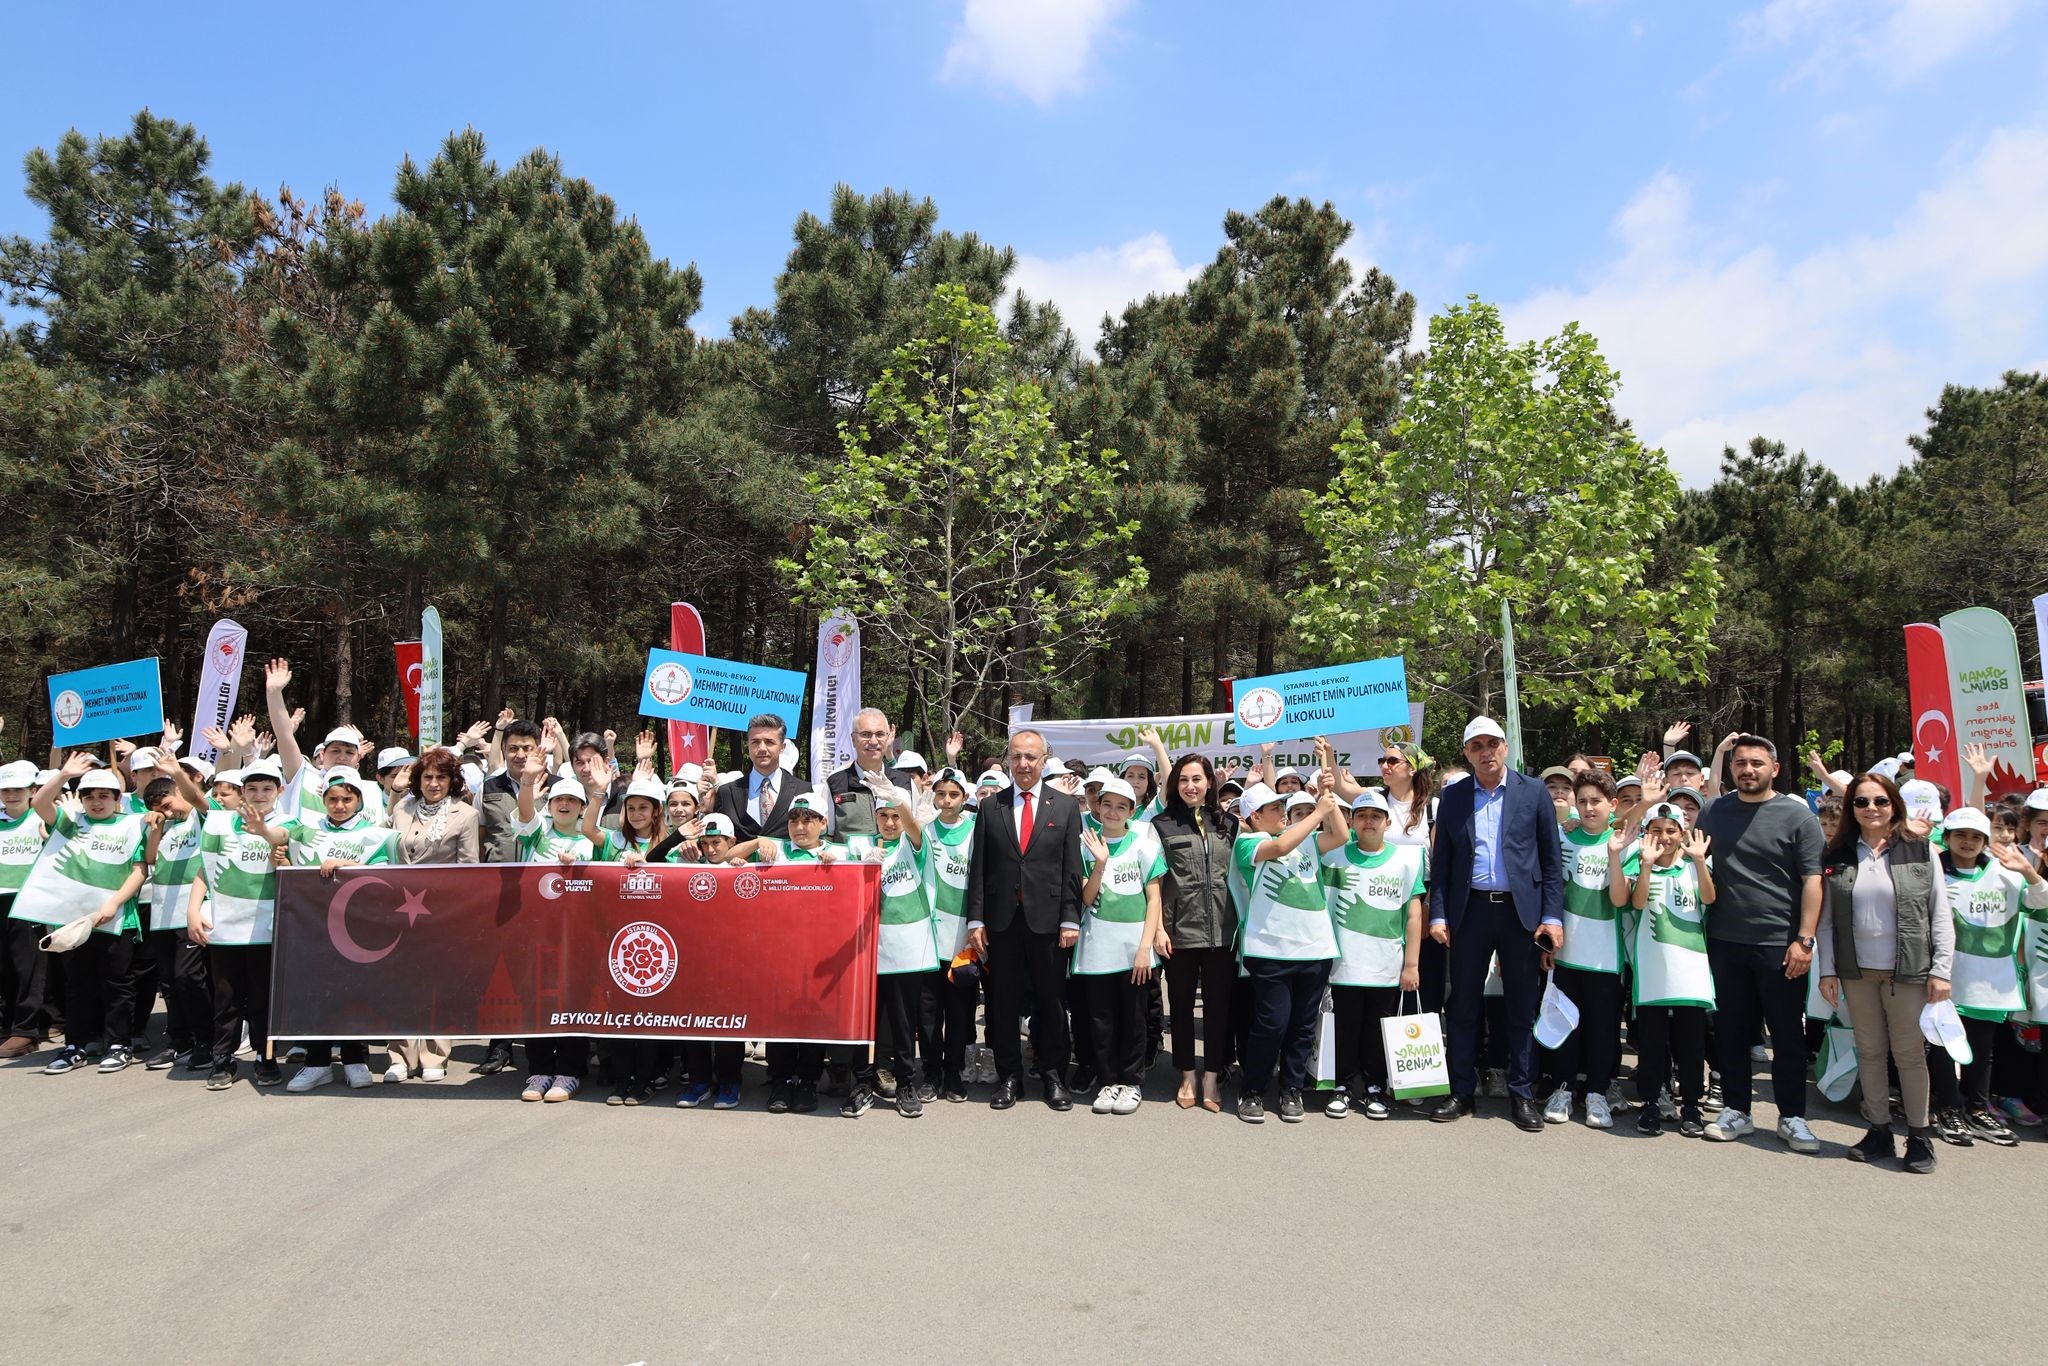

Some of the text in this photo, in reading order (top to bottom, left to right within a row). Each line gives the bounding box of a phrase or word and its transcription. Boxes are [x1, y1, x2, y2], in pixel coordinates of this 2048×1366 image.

[695, 665, 757, 683] İSTANBUL-BEYKOZ
[1283, 675, 1350, 691] İSTANBUL-BEYKOZ
[693, 678, 801, 706] MEHMET EMİN PULATKONAK
[1284, 691, 1322, 707] MEHMET
[1322, 685, 1345, 702] EMİN
[1346, 679, 1404, 699] PULATKONAK
[84, 697, 105, 710] MEHMET
[113, 704, 143, 715] ORTAOKULU
[689, 696, 748, 715] ORTAOKULU
[1285, 707, 1336, 724] İLKOKULU
[1214, 755, 1254, 772] HOŞ
[627, 925, 658, 935] İSTANBUL
[550, 1011, 748, 1029] BEYKOZ İLÇE ÖĞRENCİ MECLİSİ
[1394, 1042, 1441, 1059] ORMAN
